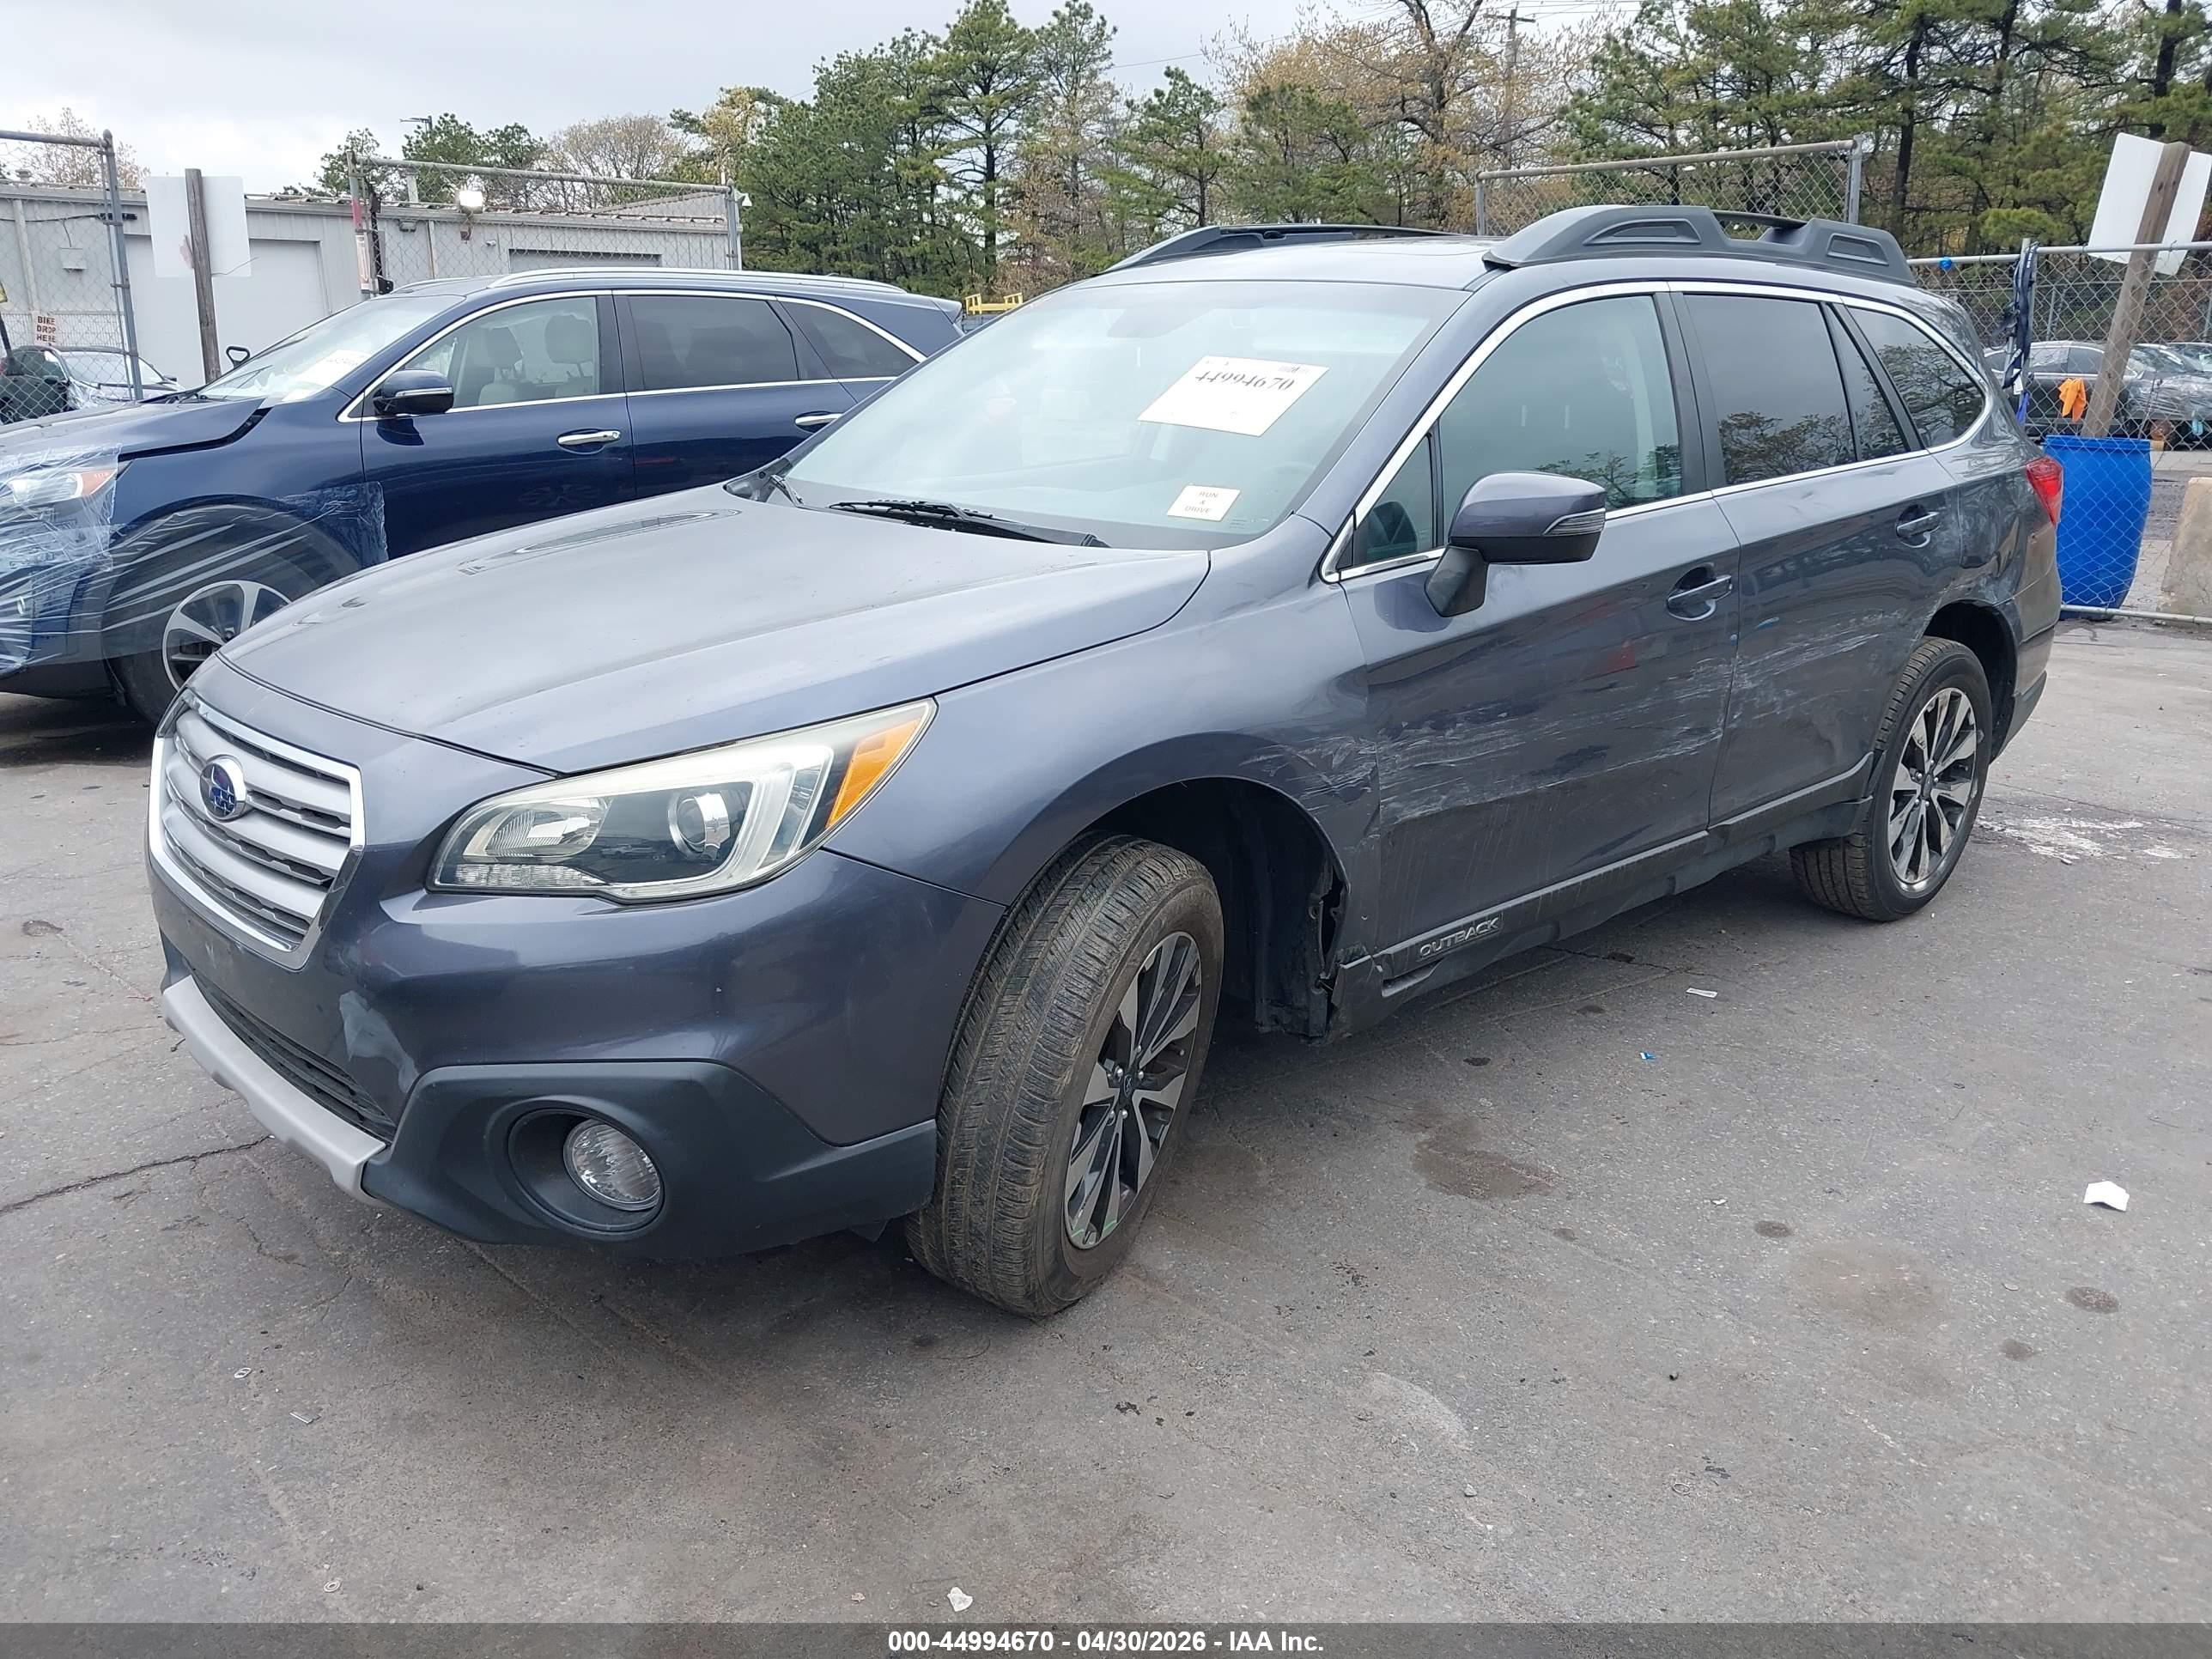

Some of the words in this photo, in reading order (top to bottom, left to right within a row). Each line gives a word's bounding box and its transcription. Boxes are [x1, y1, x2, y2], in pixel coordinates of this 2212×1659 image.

[37, 315, 56, 325] BIKE
[36, 325, 57, 334] DROP
[36, 334, 57, 343] HERE
[1194, 370, 1296, 391] 44994670
[1419, 916, 1500, 958] OUTBACK
